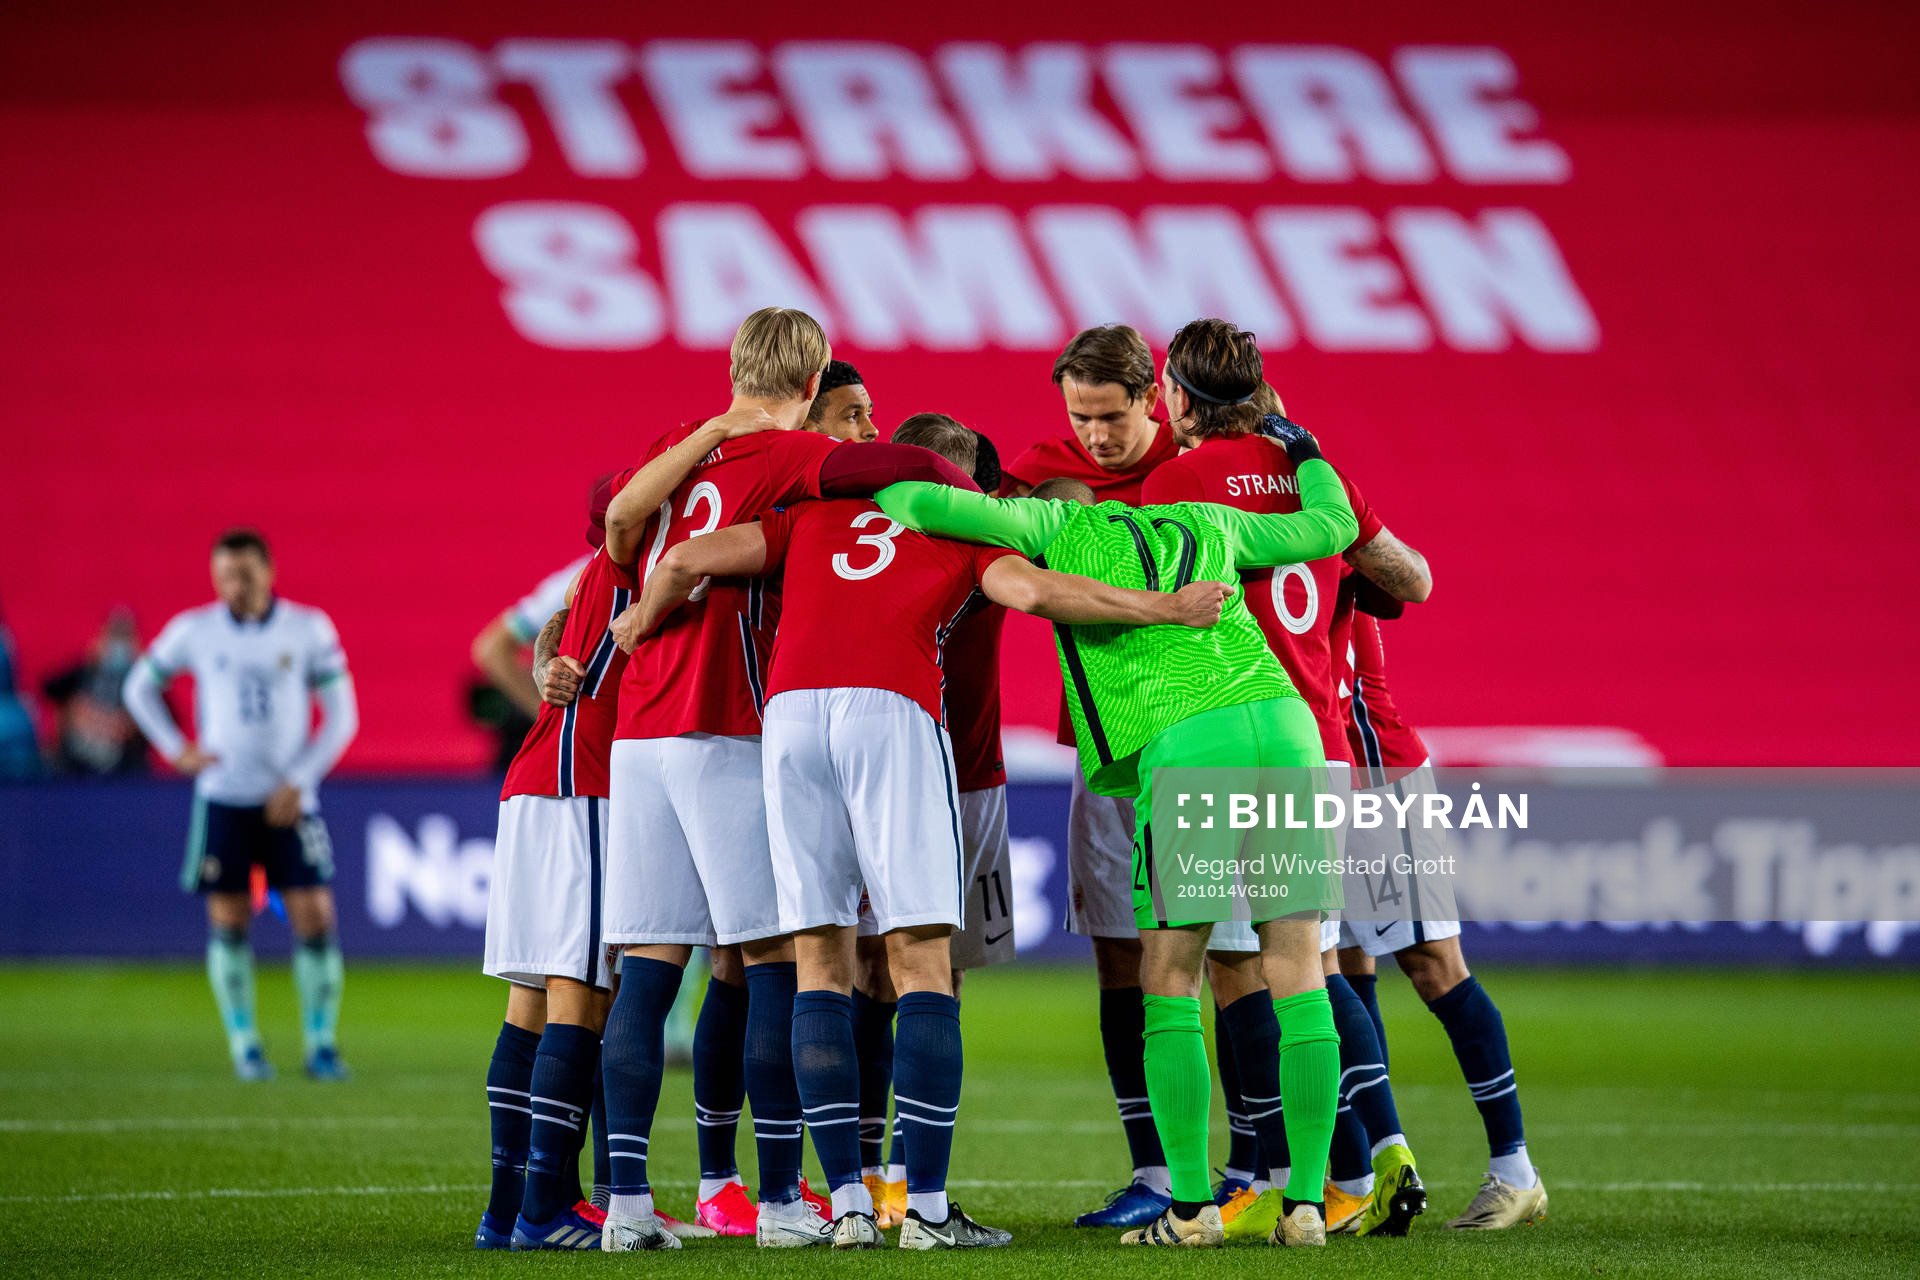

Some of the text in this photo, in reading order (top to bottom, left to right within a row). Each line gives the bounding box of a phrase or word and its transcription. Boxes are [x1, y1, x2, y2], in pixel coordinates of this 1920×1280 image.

[340, 37, 1572, 184] STERKERE
[473, 201, 1601, 352] SAMMEN
[832, 511, 907, 580] 3
[977, 869, 1009, 922] 11
